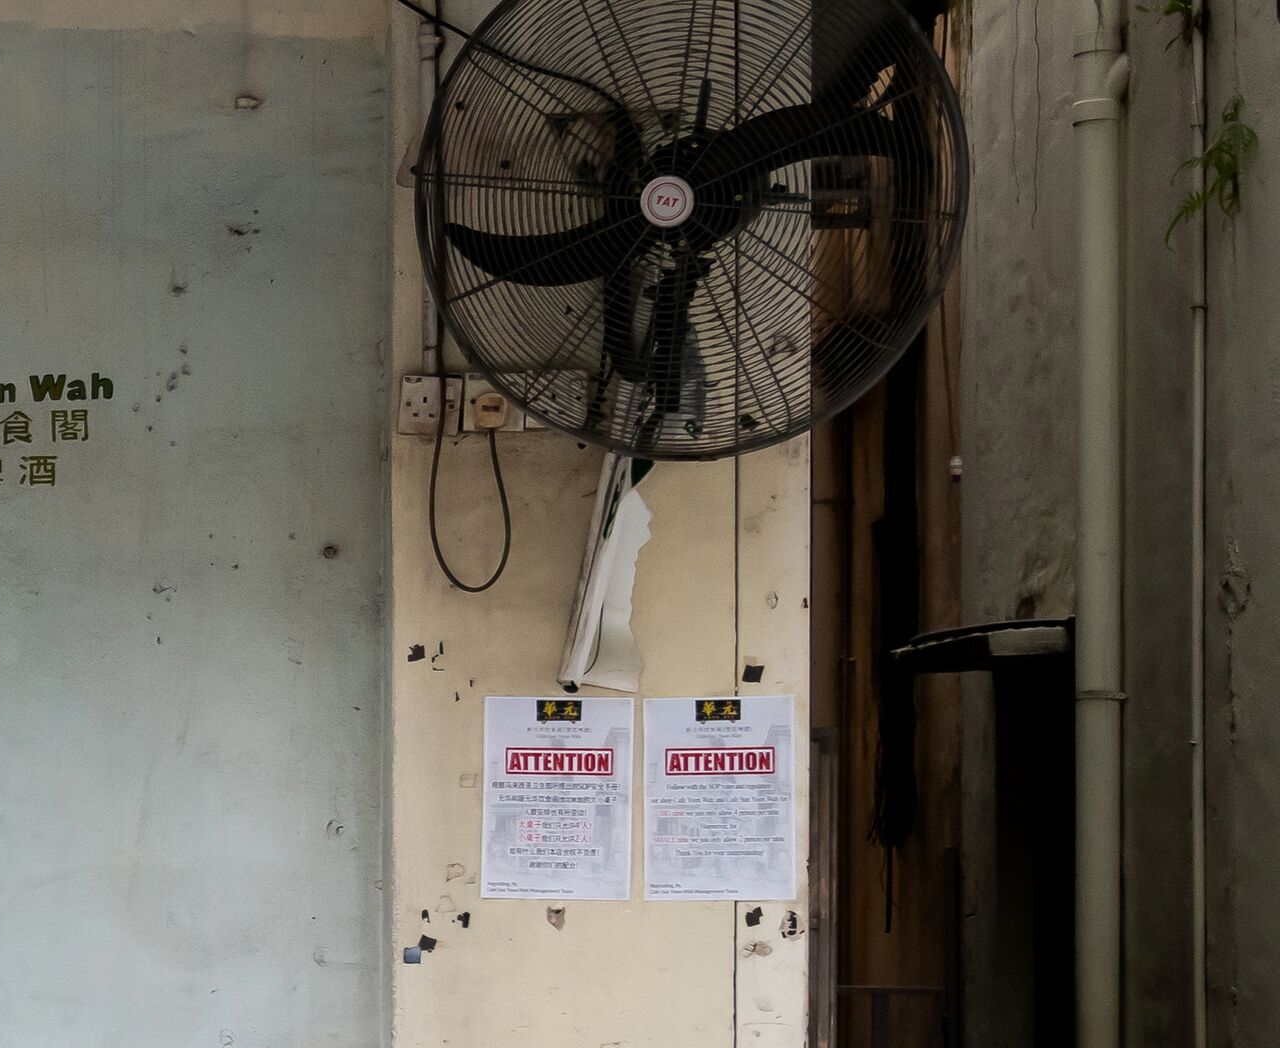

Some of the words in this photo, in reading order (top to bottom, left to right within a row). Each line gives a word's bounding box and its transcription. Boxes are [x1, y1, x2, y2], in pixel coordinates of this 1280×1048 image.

[656, 195, 679, 208] TAT
[30, 373, 115, 402] Wah
[509, 752, 609, 771] ATTENTION
[669, 752, 770, 771] ATTENTION
